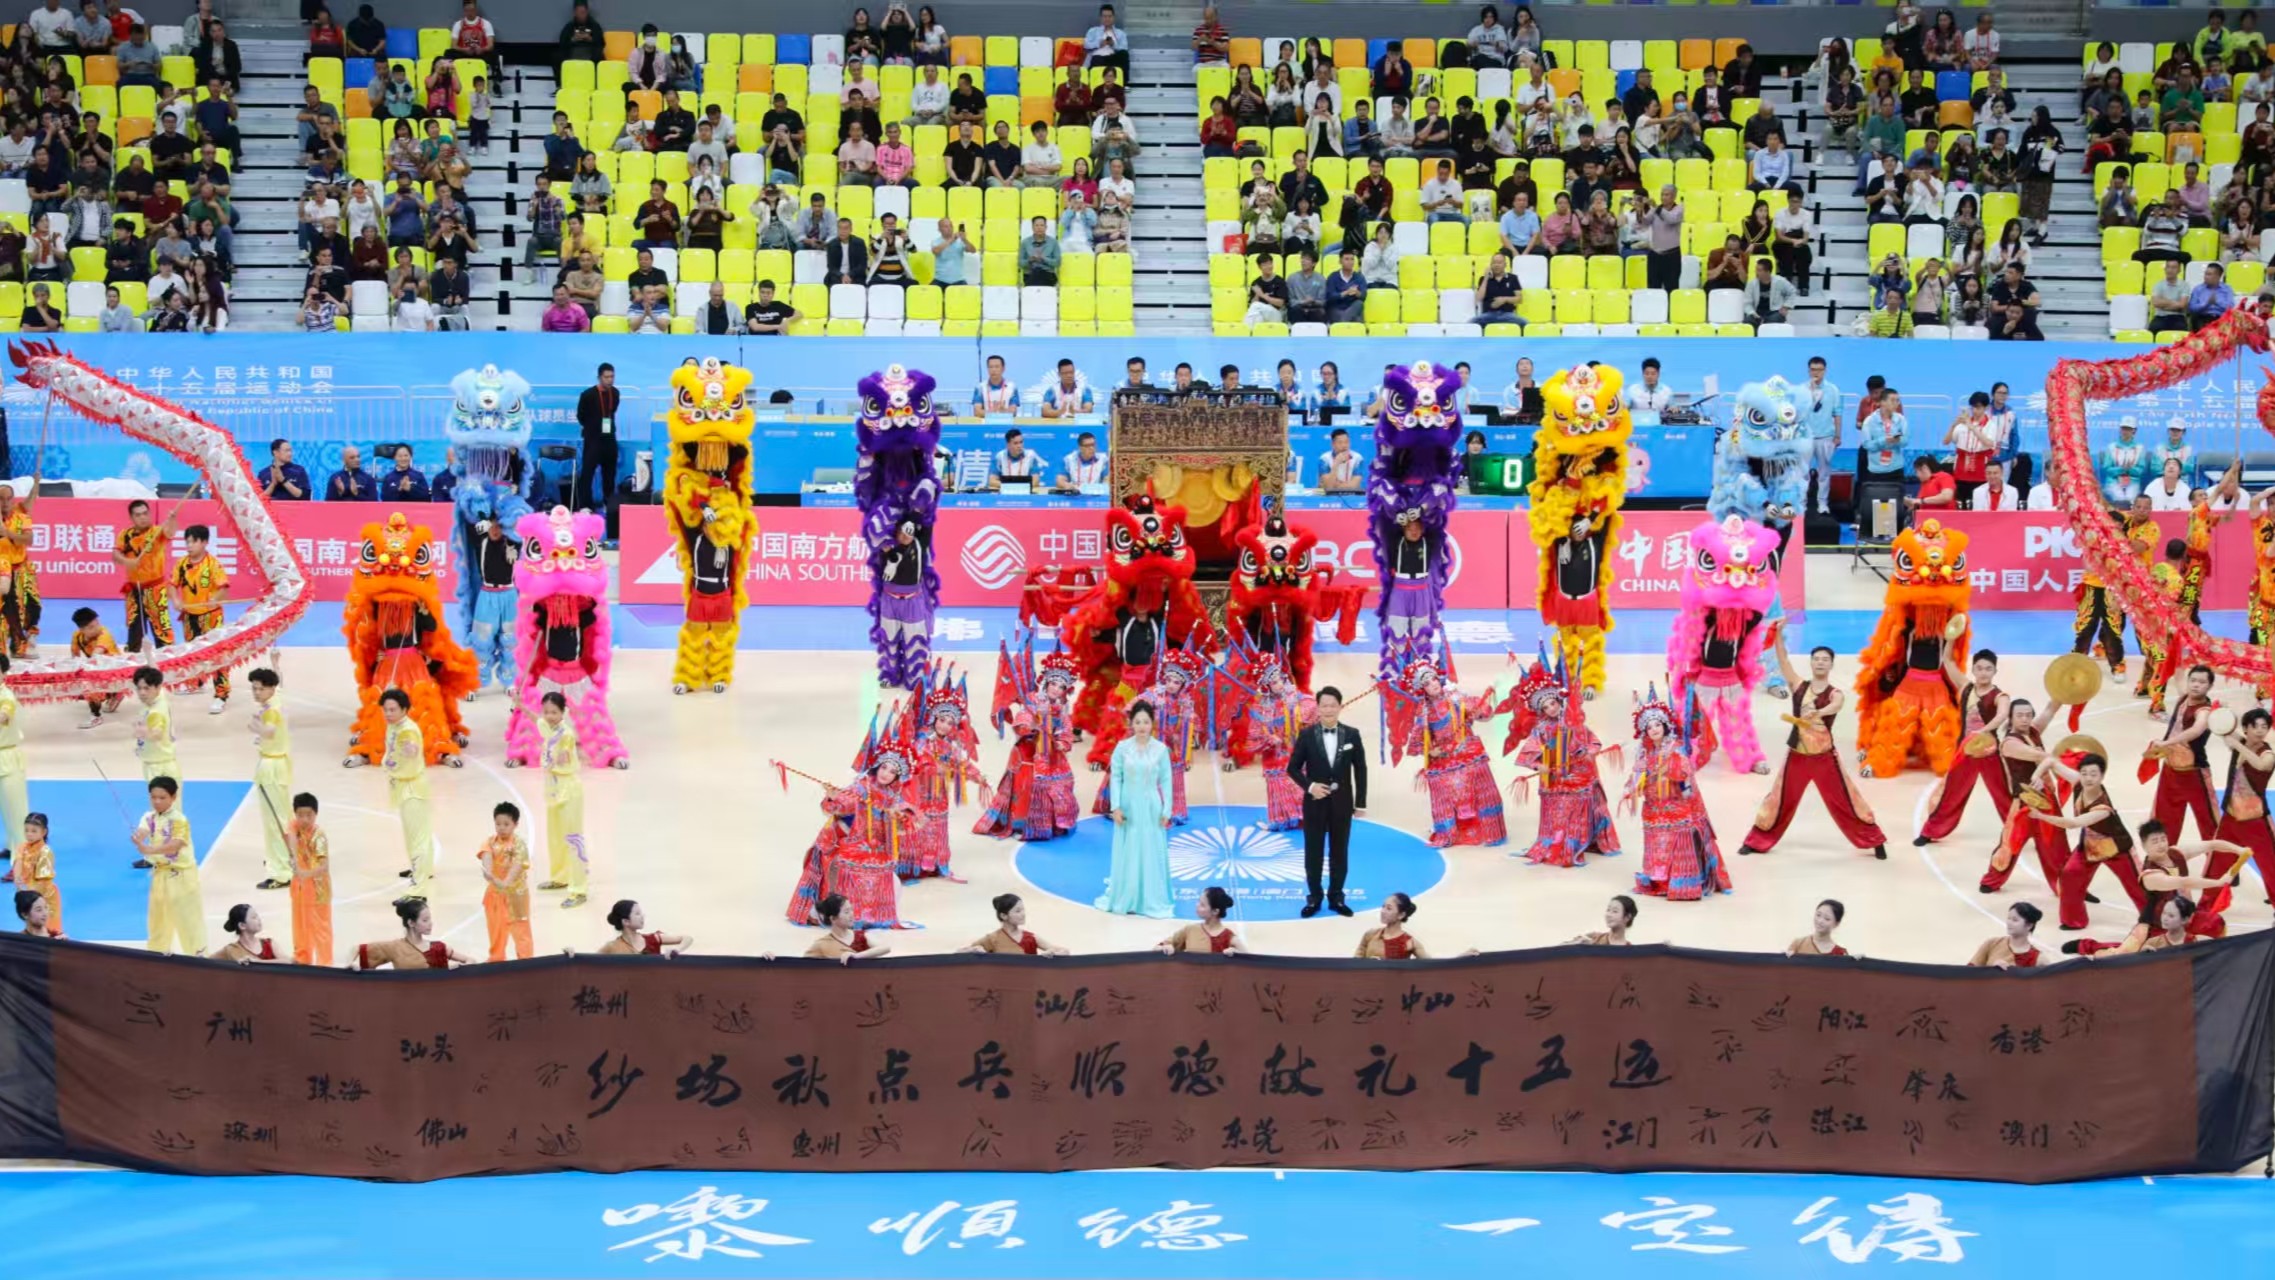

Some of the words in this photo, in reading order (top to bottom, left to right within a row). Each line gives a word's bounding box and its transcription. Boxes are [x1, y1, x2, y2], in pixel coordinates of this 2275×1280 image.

[116, 365, 333, 380] 中华人民共和国
[1503, 458, 1523, 489] 0
[1039, 528, 1101, 561] 中国
[46, 558, 116, 574] unicom
[746, 564, 791, 581] HINA
[798, 563, 874, 582] SOUTHE
[1619, 578, 1681, 592] CHINA
[572, 985, 629, 1018] 梅州
[1034, 986, 1096, 1023] 汕尾
[1401, 984, 1455, 1016] 中山
[205, 1011, 253, 1046] 广州
[1817, 1005, 1869, 1032] 阳江
[400, 1033, 454, 1063] 汕头
[1990, 1024, 2052, 1055] 香港
[307, 1074, 370, 1102] 珠海
[223, 1121, 278, 1151] 深圳
[416, 1117, 467, 1148] 佛山
[1222, 1116, 1284, 1155] 东莞
[1602, 1117, 1659, 1149] 江门
[1810, 1107, 1868, 1135] 湛江
[2000, 1120, 2049, 1148] 澳门
[791, 1128, 841, 1159] 惠州
